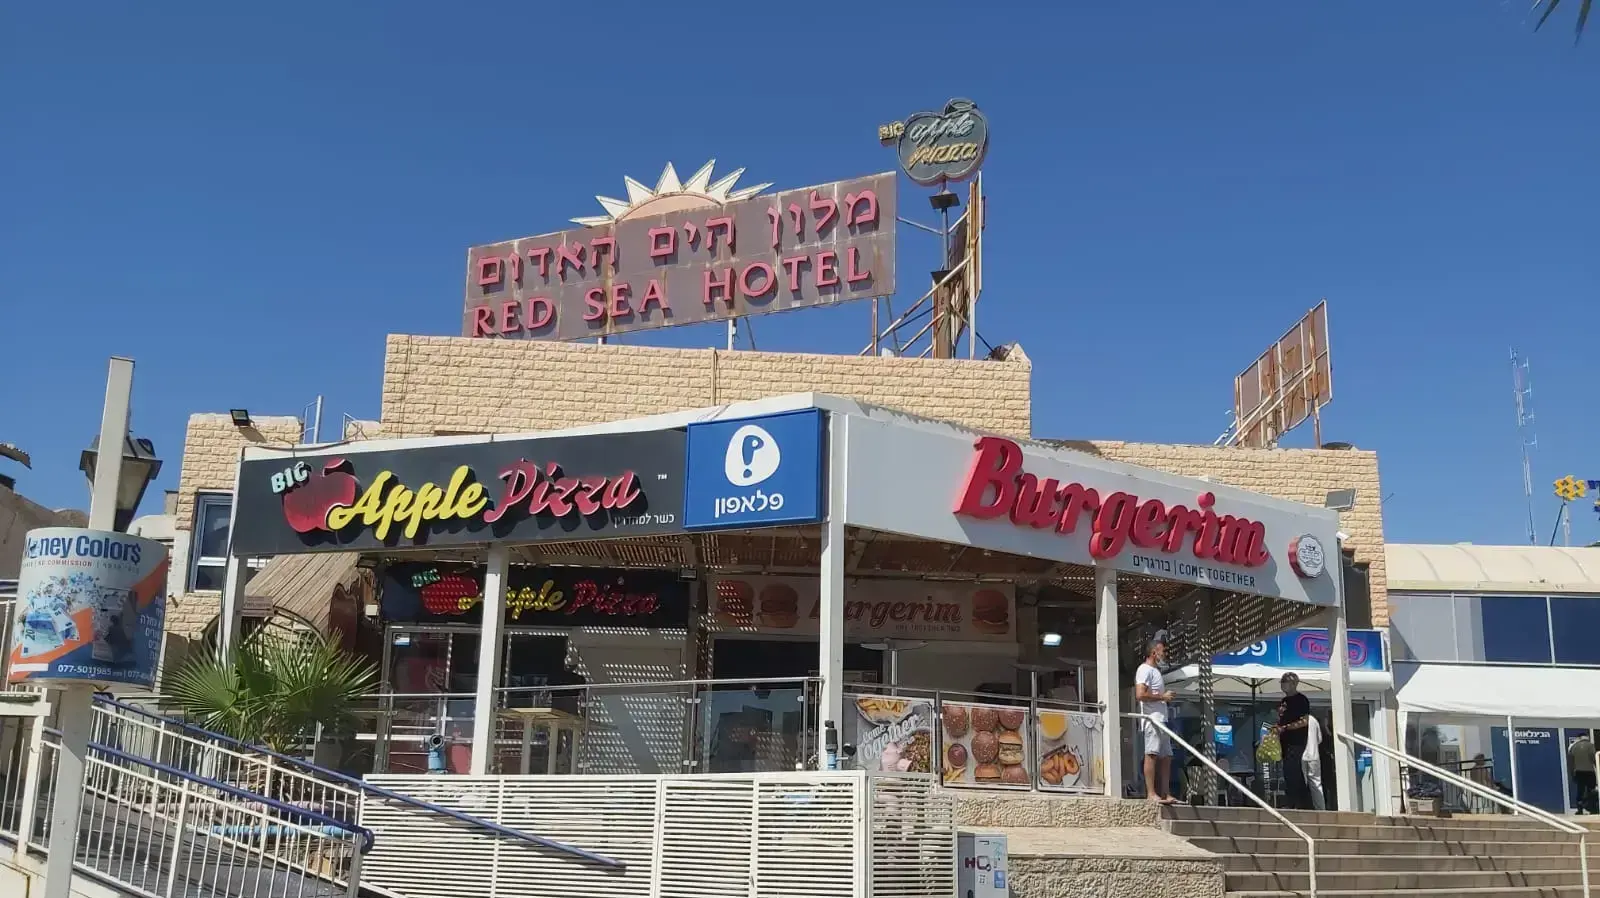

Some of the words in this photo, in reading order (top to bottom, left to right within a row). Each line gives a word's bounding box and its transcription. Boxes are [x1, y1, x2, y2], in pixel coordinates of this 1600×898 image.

[648, 217, 735, 258] הים
[768, 189, 880, 248] מלון
[476, 236, 617, 286] האדום
[472, 296, 554, 337] RED
[583, 279, 670, 322] SEA
[703, 246, 871, 304] HOTEL
[271, 461, 308, 494] BIG
[327, 465, 488, 541] Apple
[484, 458, 642, 524] Pizza
[653, 513, 675, 525] כשר
[714, 489, 785, 519] פלאפון
[953, 436, 1269, 567] Burgerim
[1132, 554, 1171, 572] בורגרים
[1179, 563, 1205, 578] COME
[1207, 568, 1255, 587] TOGETHER
